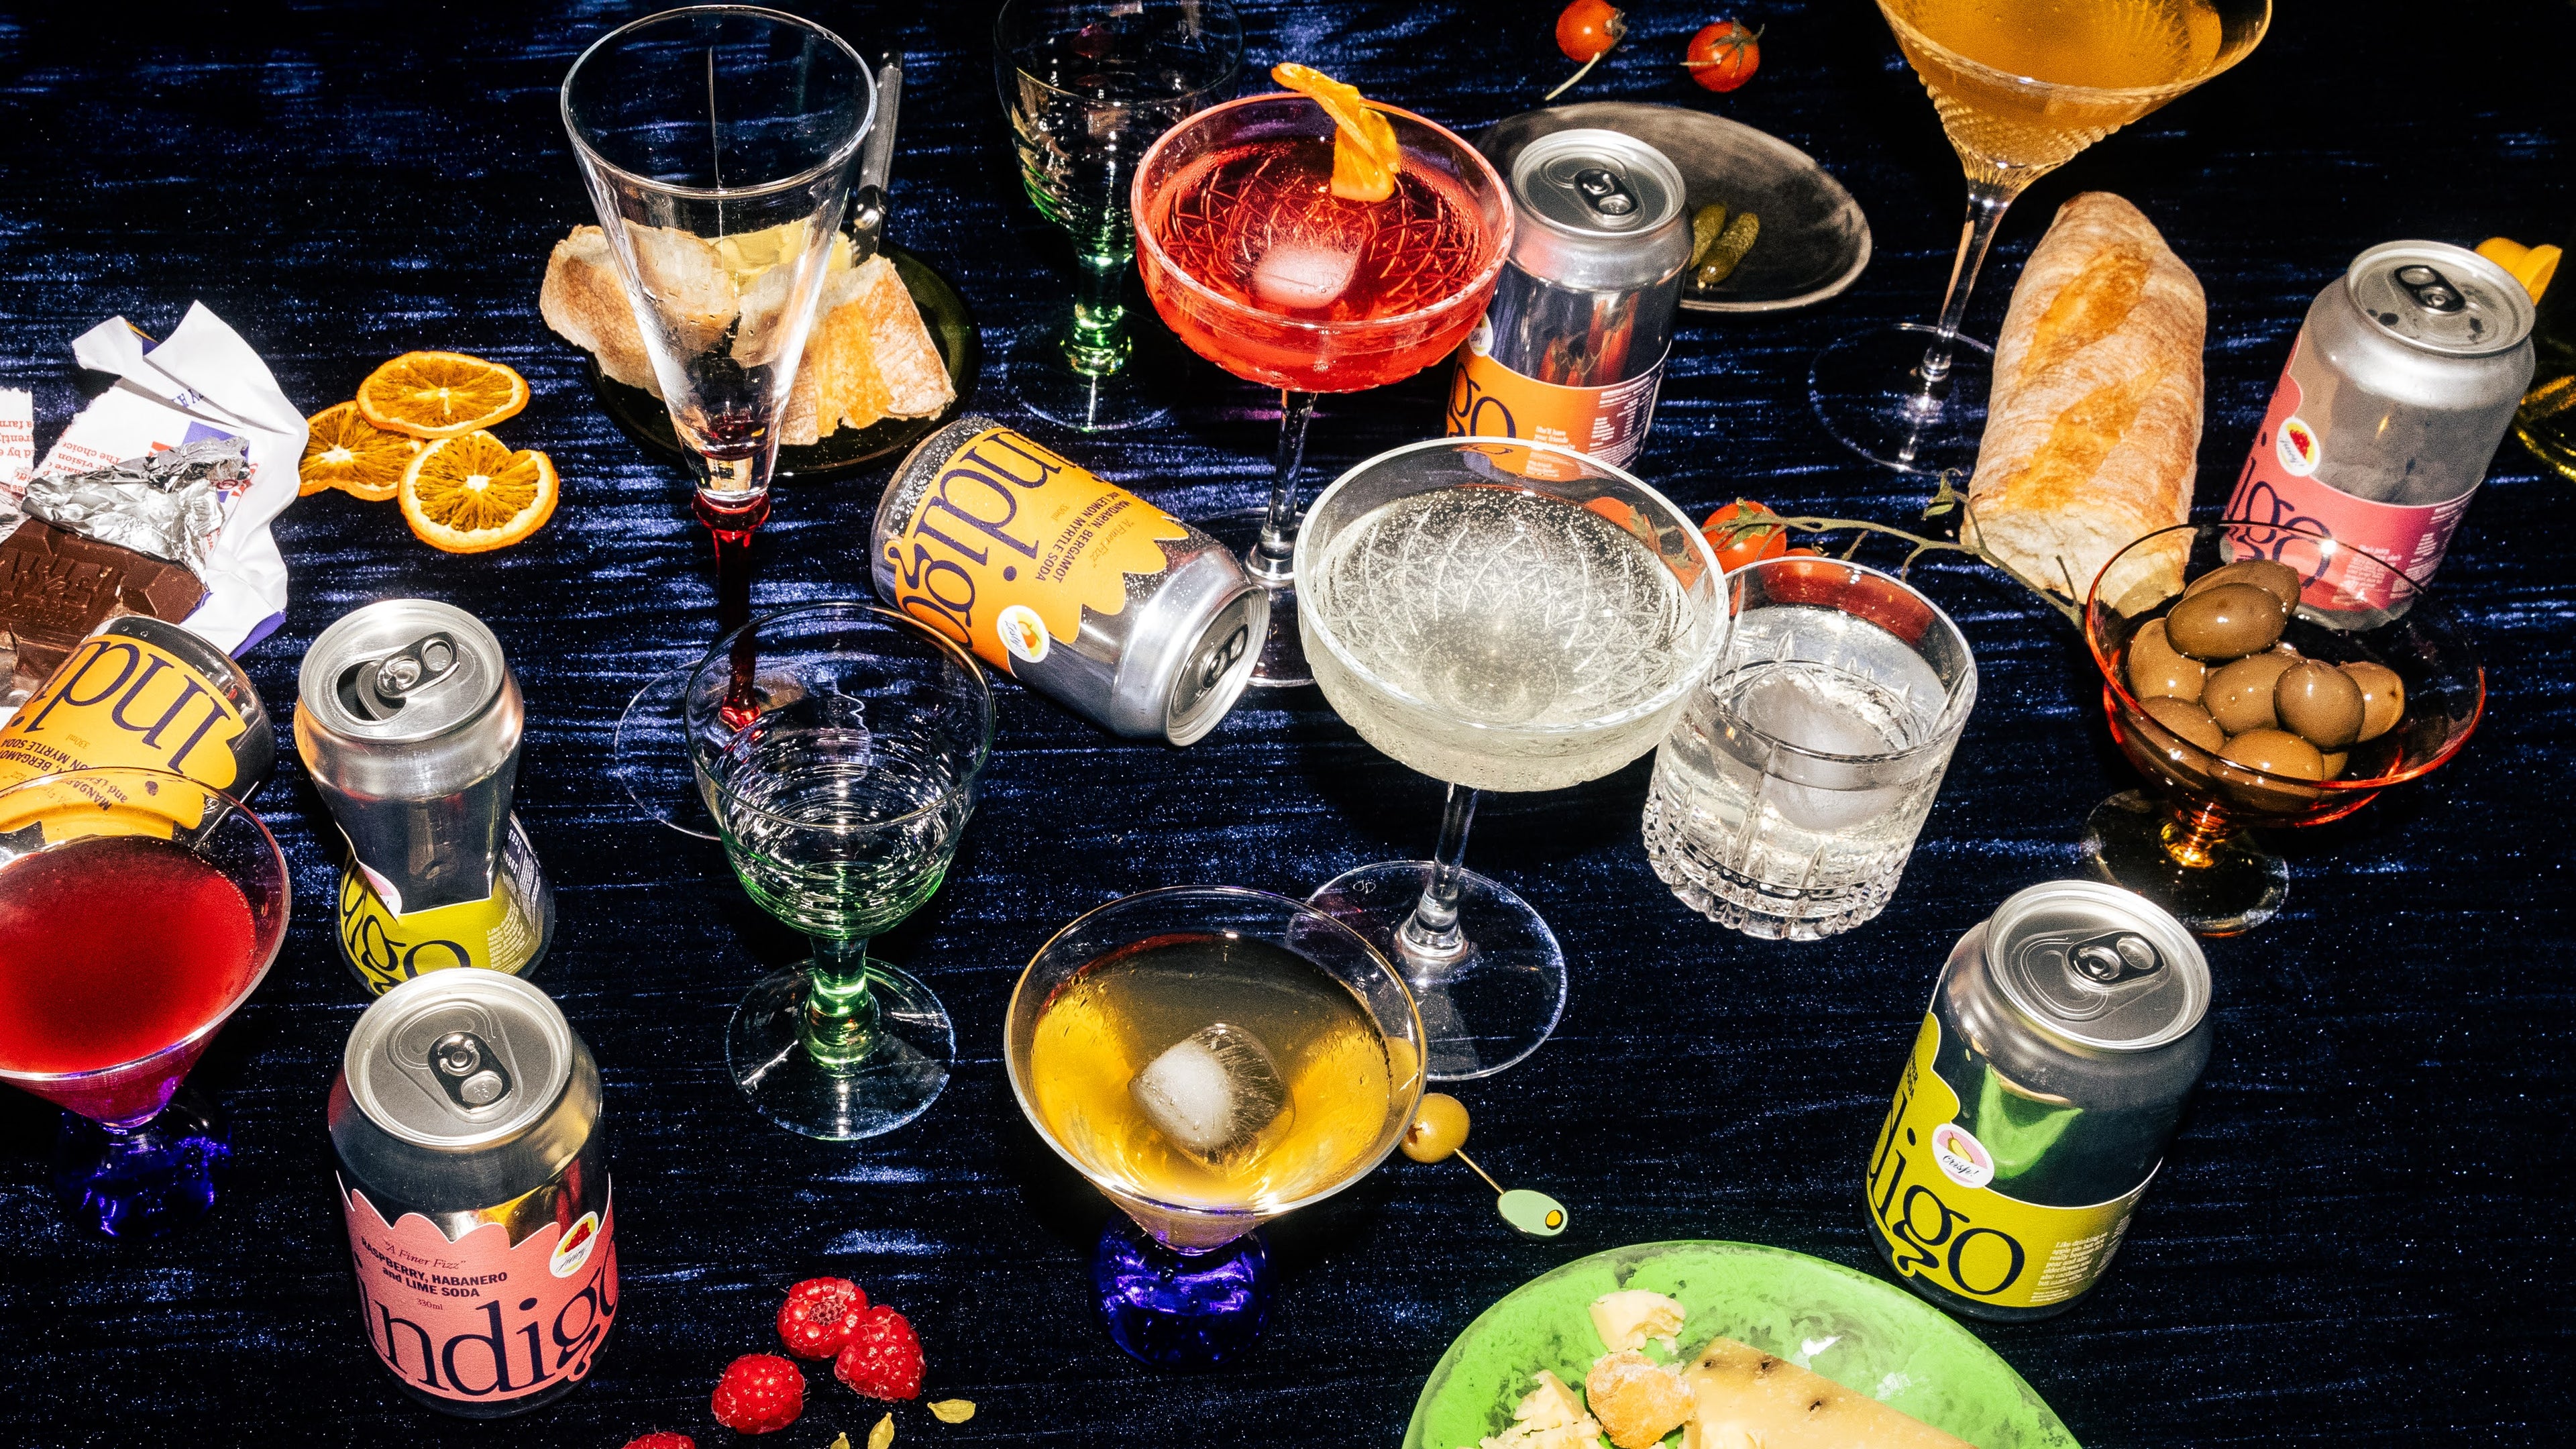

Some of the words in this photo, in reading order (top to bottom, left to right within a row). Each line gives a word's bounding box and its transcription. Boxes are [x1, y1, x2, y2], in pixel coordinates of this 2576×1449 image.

[7, 447, 21, 458] by
[58, 453, 93, 468] vision
[99, 453, 121, 465] The
[1081, 496, 1111, 518] LEMON
[1087, 500, 1132, 529] MANDARIN,
[1053, 517, 1087, 553] MYRTLE
[1107, 524, 1126, 545] Finer
[1035, 552, 1058, 582] SODA
[1053, 529, 1094, 584] BERGAMOT
[25, 741, 71, 765] MYRTLE
[108, 784, 129, 804] and
[361, 1236, 429, 1283] RASPBERRY,
[431, 1272, 508, 1287] HABANERO
[399, 1250, 431, 1267] Finer
[382, 1267, 402, 1283] and
[406, 1277, 438, 1295] LIME
[441, 1287, 480, 1298] SODA
[416, 1297, 443, 1311] 330ml
